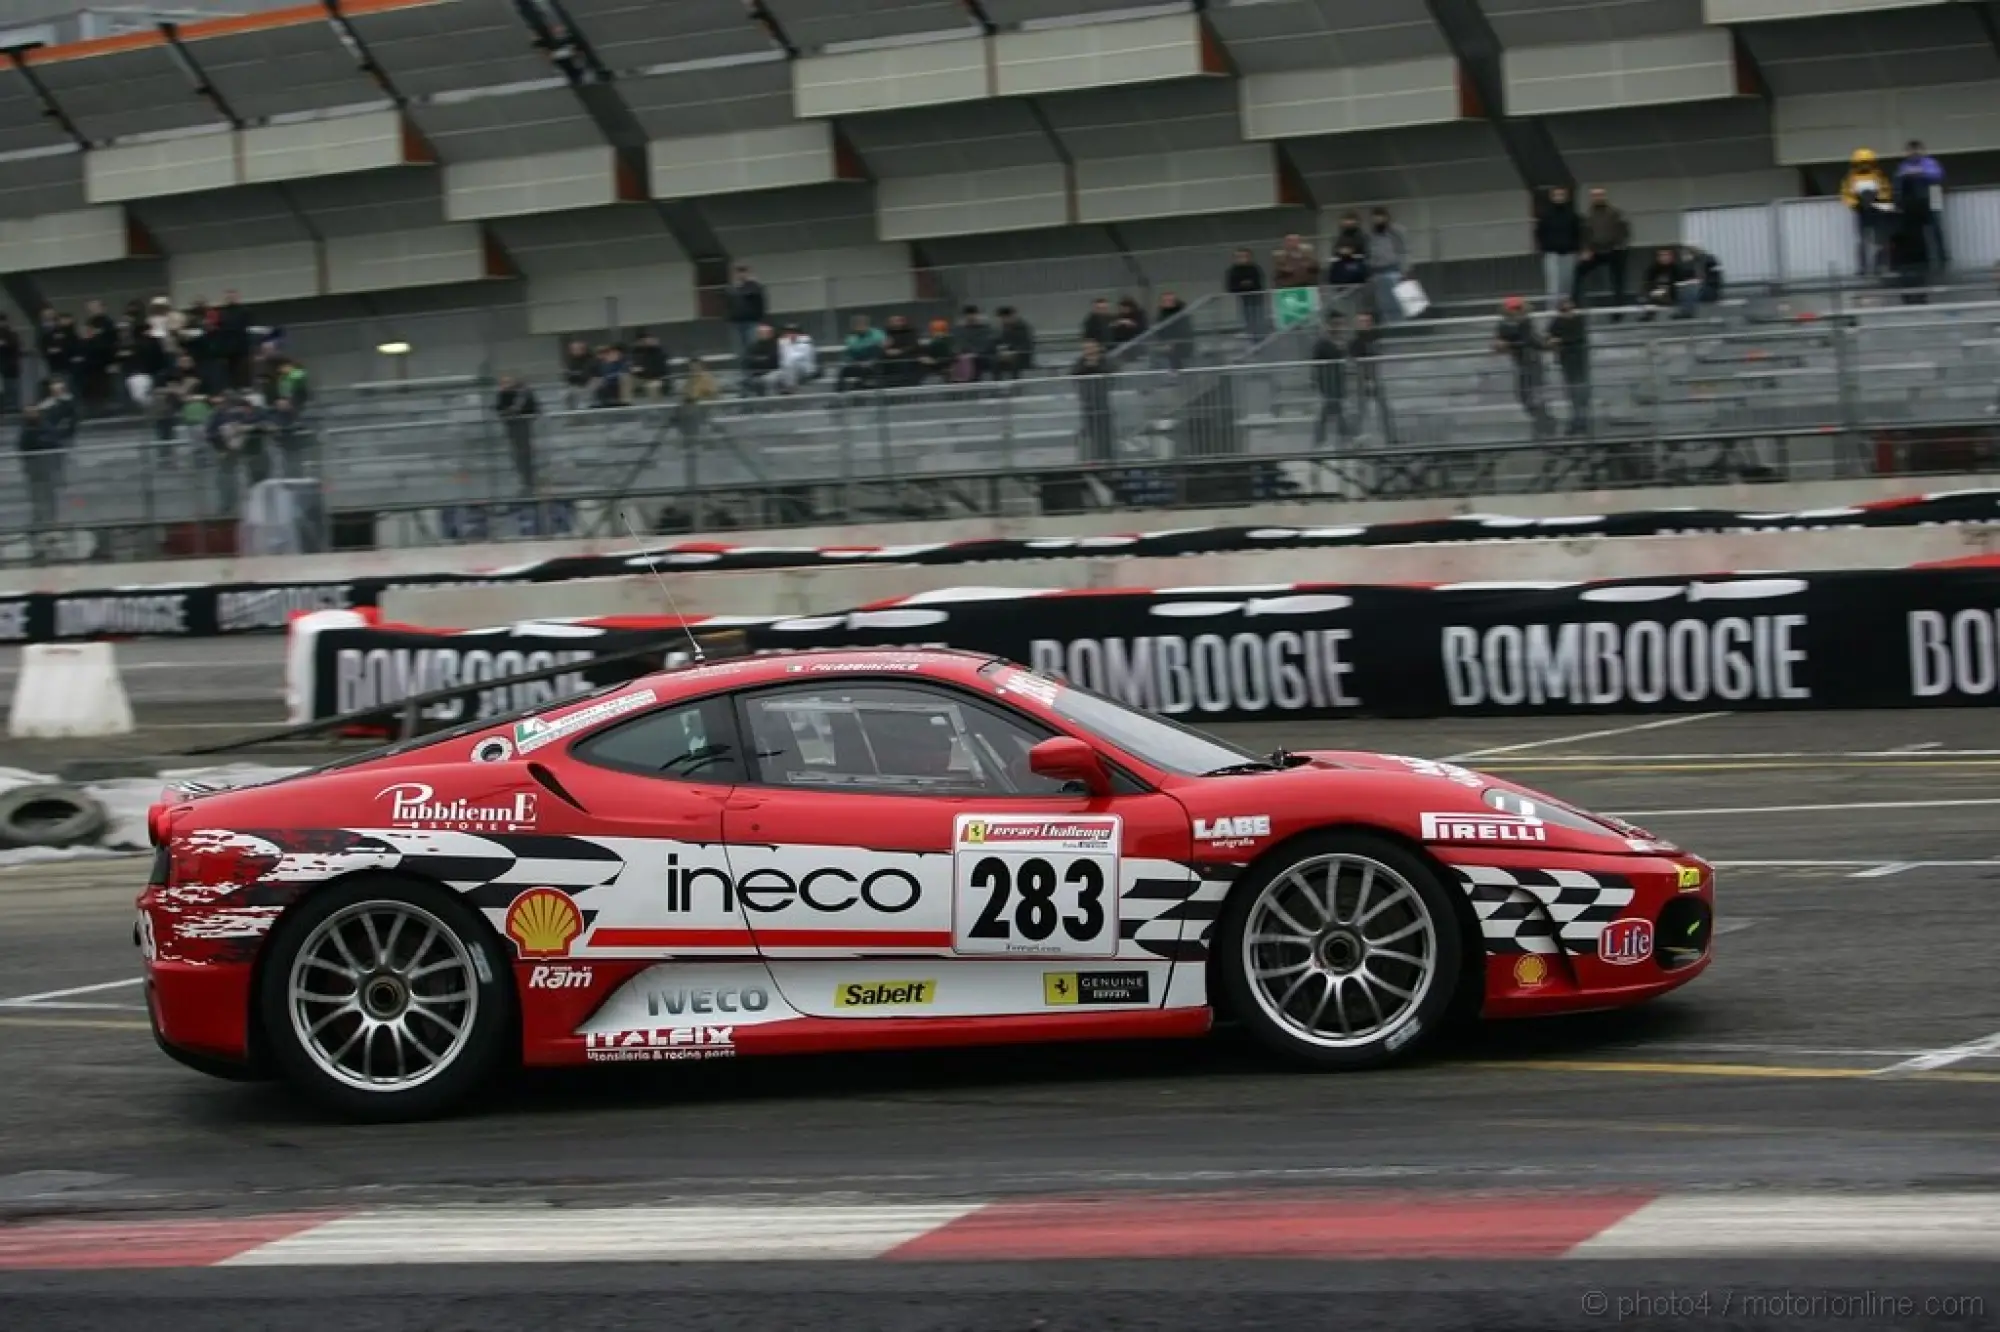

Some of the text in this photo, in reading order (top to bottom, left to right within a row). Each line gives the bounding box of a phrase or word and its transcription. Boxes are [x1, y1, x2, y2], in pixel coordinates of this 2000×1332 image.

[1441, 614, 1811, 706] BOMBOOGIE
[1906, 607, 2000, 697] BO
[375, 782, 538, 823] PubbliennE
[430, 820, 498, 832] STORE
[985, 821, 1111, 842] Ferrari Challenge
[1193, 814, 1270, 839] LABE
[1420, 812, 1545, 841] PIRELLI
[667, 853, 922, 913] ineco
[968, 857, 1105, 942] 283
[1604, 925, 1650, 957] Life
[529, 966, 593, 989] Ram
[1081, 976, 1145, 988] GENUINE
[648, 983, 770, 1016] IVECO
[845, 983, 926, 1006] Sabelt
[586, 1026, 735, 1048] ITALFIX
